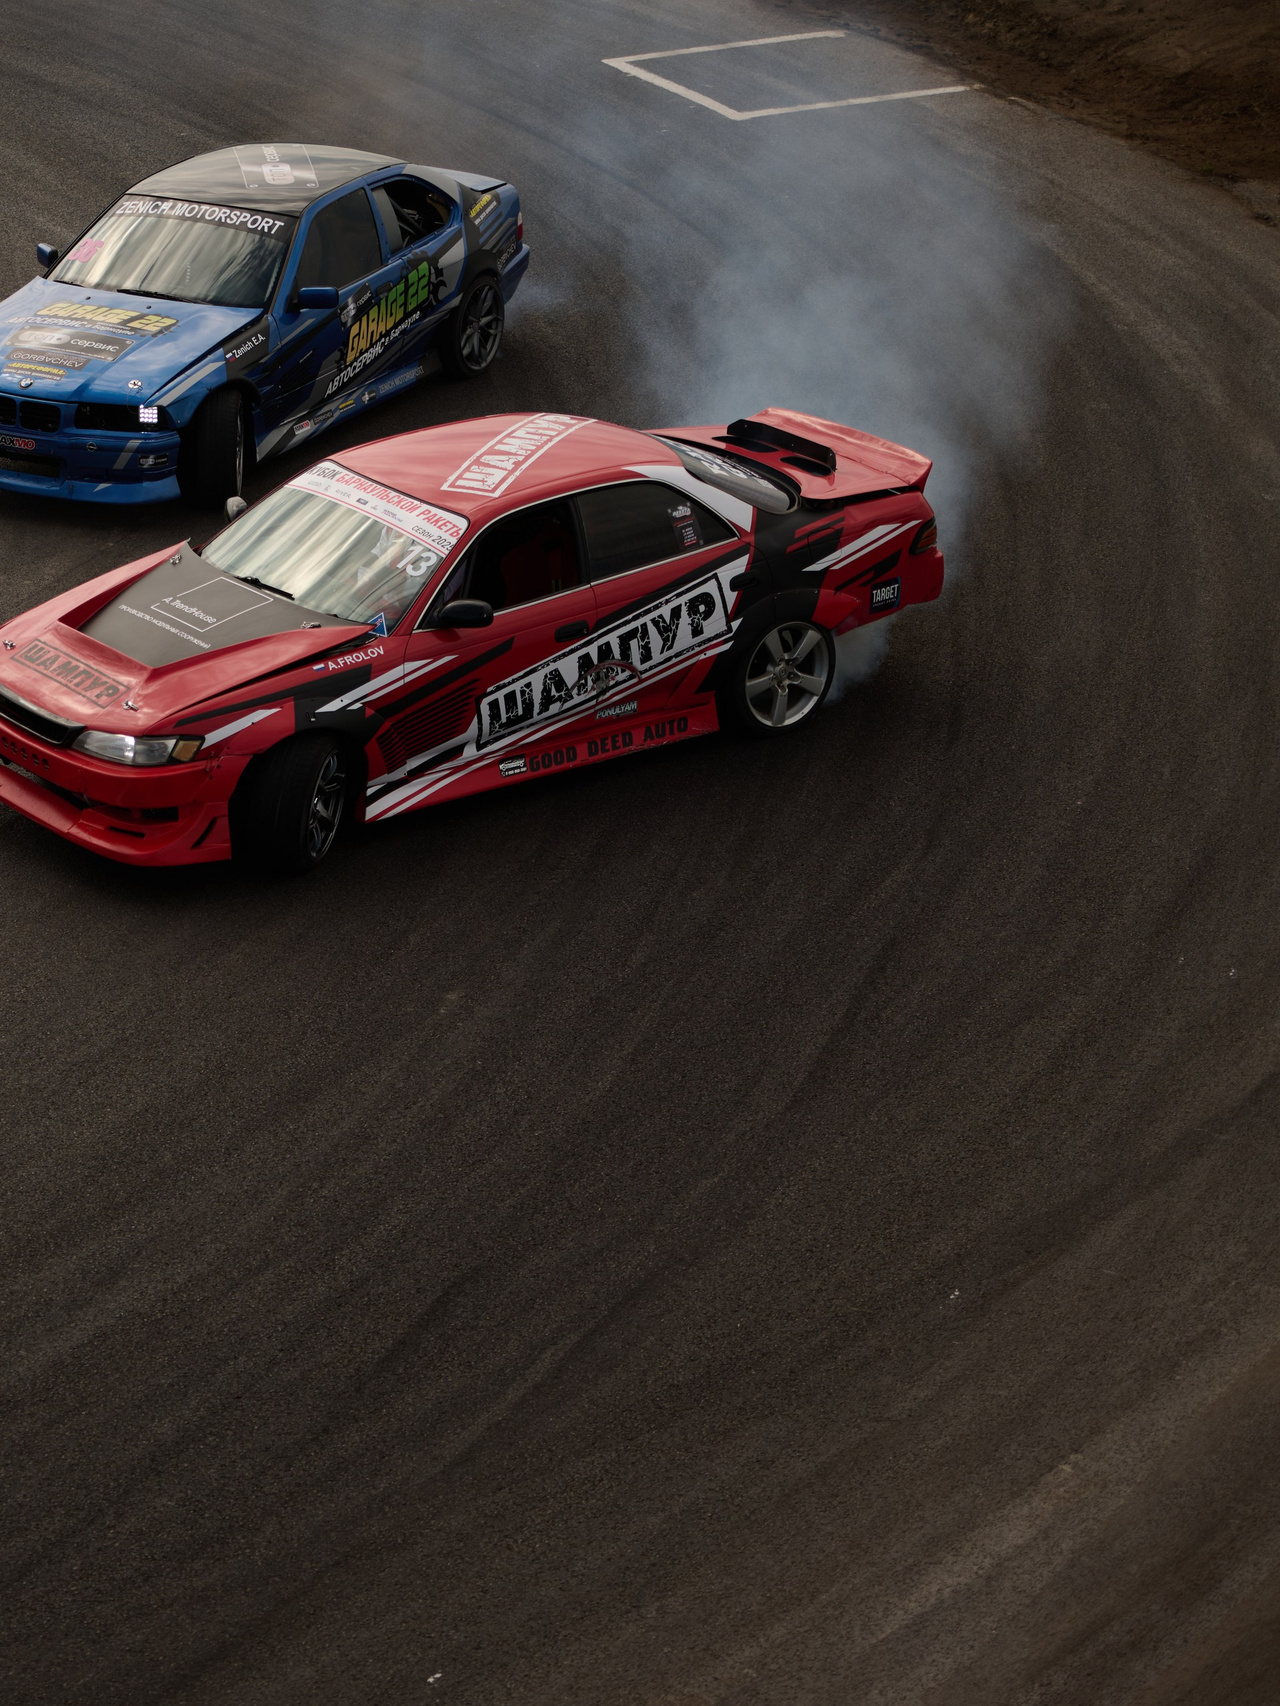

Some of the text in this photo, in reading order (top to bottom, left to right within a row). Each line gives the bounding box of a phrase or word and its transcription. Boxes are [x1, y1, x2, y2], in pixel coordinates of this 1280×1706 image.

[116, 200, 285, 235] ZENICH MOTORSPORT
[68, 237, 105, 264] 36
[36, 303, 141, 325] GARAGE
[125, 314, 178, 332] 22
[346, 261, 430, 365] GARAGE 22
[70, 337, 120, 352] сервис
[232, 333, 266, 359] Zenich E.A.
[323, 337, 385, 399] АВТОСЕРВИС
[394, 365, 425, 388] MOTORSPORT
[454, 415, 579, 491] ШАМПУР
[307, 466, 342, 481] КУБОК
[335, 473, 424, 514] БАРНАУЛЬСКОЙ
[411, 525, 456, 551] СЕЗОН 2025
[396, 545, 438, 577] 13
[872, 584, 899, 603] TARGET
[19, 644, 120, 699] ШАМПУР
[327, 645, 385, 671] A.FROLOV
[486, 591, 717, 737] ШАМПУР
